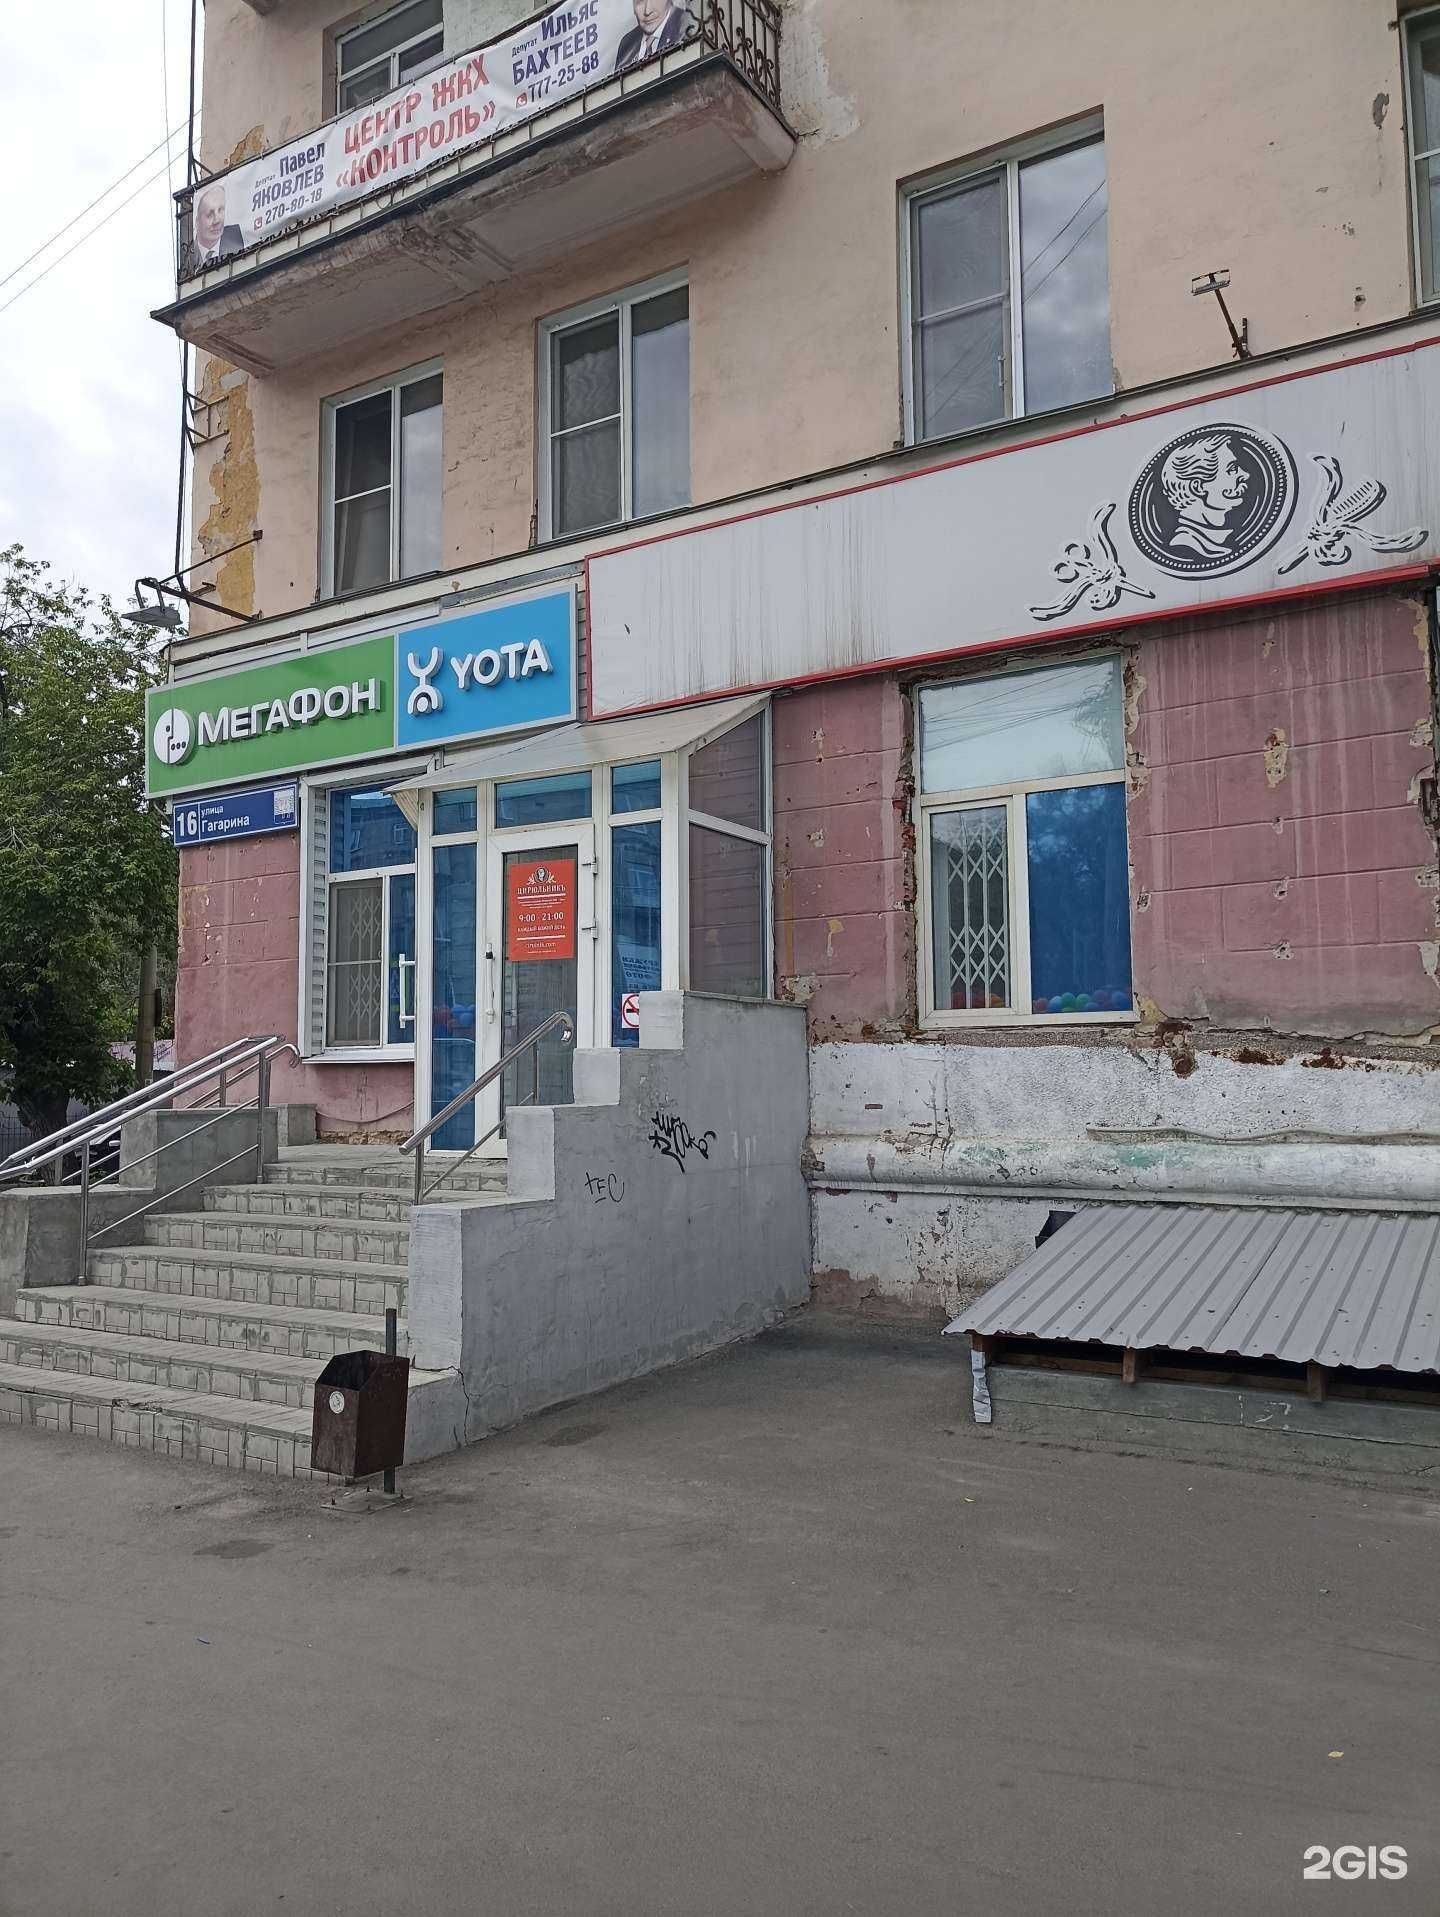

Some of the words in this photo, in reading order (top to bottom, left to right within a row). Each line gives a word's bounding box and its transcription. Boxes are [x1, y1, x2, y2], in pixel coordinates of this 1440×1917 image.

[512, 38, 537, 58] Депутат
[541, 0, 599, 40] Ильяс
[512, 23, 598, 86] БАХТЕЕВ
[528, 51, 599, 102] 777-25-88
[344, 92, 422, 155] ЦЕНТР
[431, 53, 490, 111] ЖКХ
[279, 142, 325, 177] Павел
[336, 100, 496, 188] «КОНТРОЛЬ»
[251, 163, 324, 212] ЯКОВЛЕВ
[265, 187, 323, 224] 270-80-18
[451, 639, 552, 690] YOTA
[198, 677, 383, 747] МЕГАФОН
[177, 810, 198, 837] 16
[201, 805, 224, 818] улица
[201, 815, 250, 833] Гагарина
[518, 913, 536, 923] 9:00
[541, 911, 564, 921] 21:00
